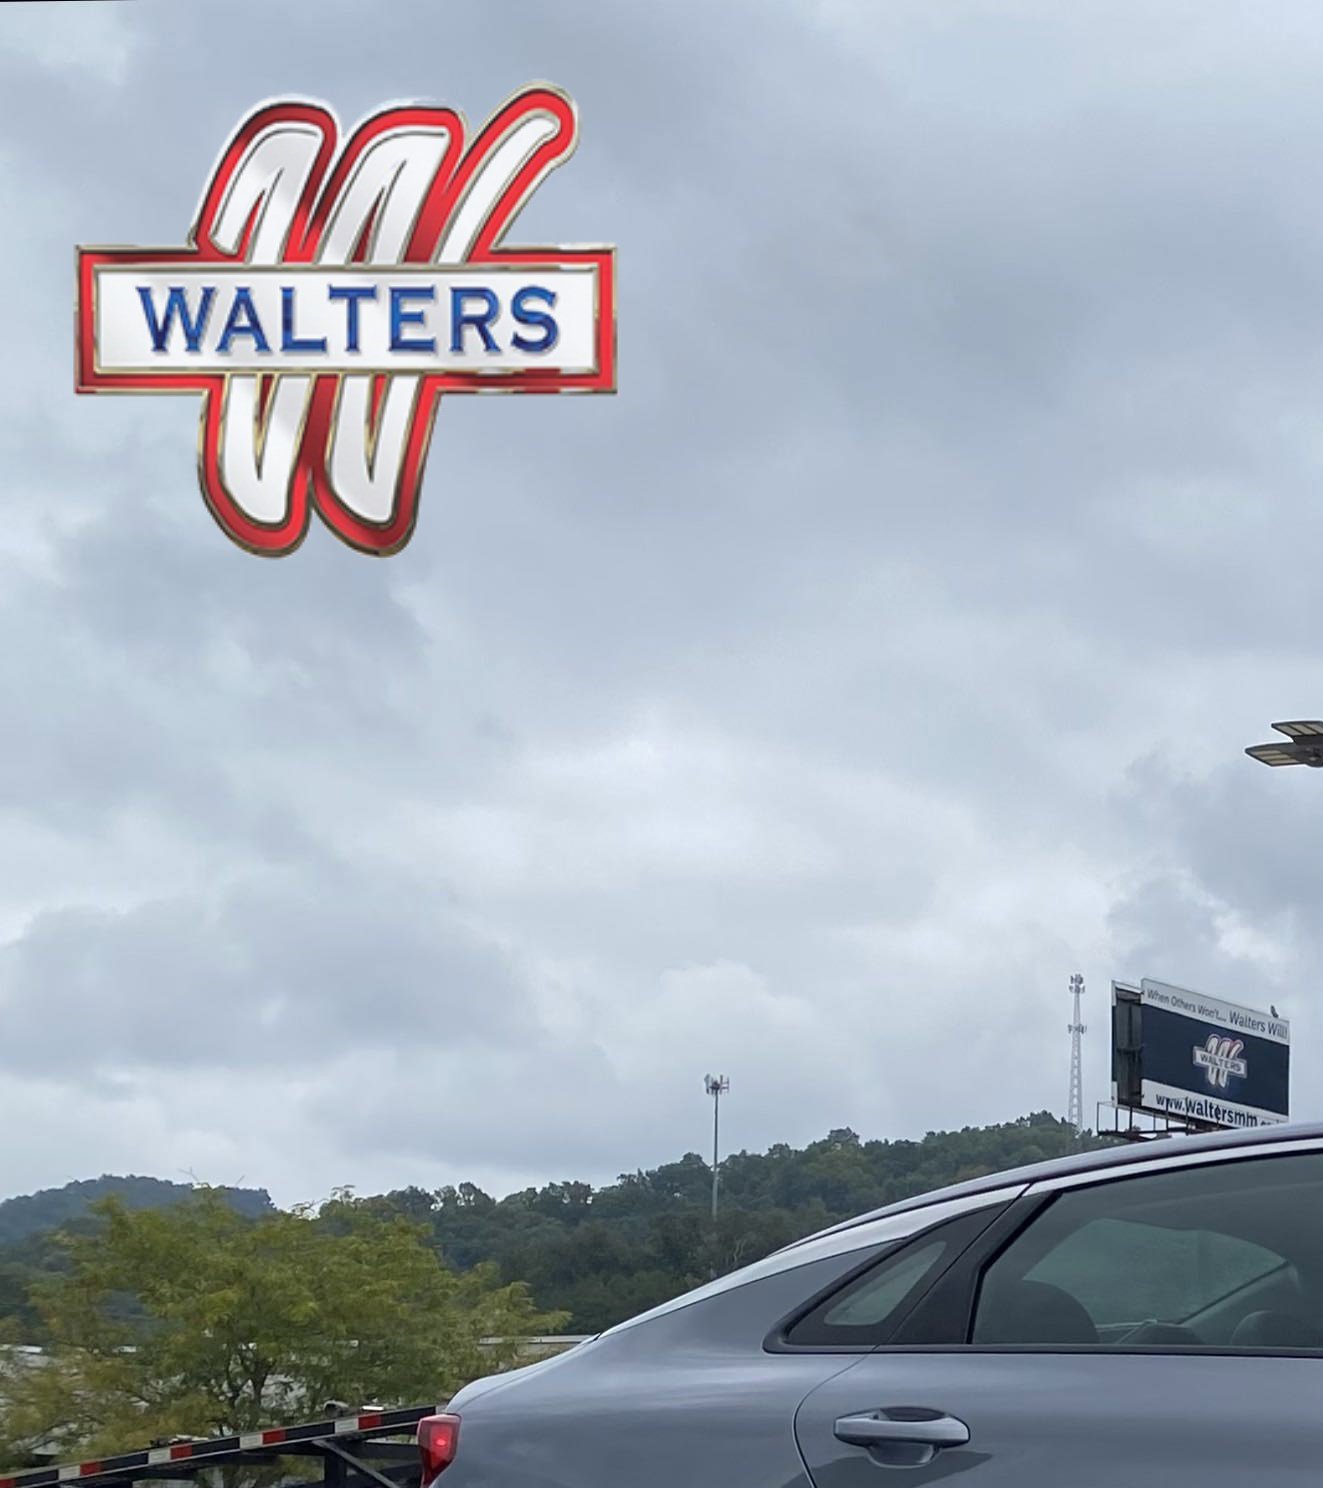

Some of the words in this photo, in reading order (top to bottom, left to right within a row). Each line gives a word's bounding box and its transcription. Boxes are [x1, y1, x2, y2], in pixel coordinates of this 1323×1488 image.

[1147, 989, 1170, 1004] When
[1171, 996, 1196, 1012] Others
[1229, 1011, 1266, 1032] Walters
[1200, 1054, 1242, 1072] WALTERS
